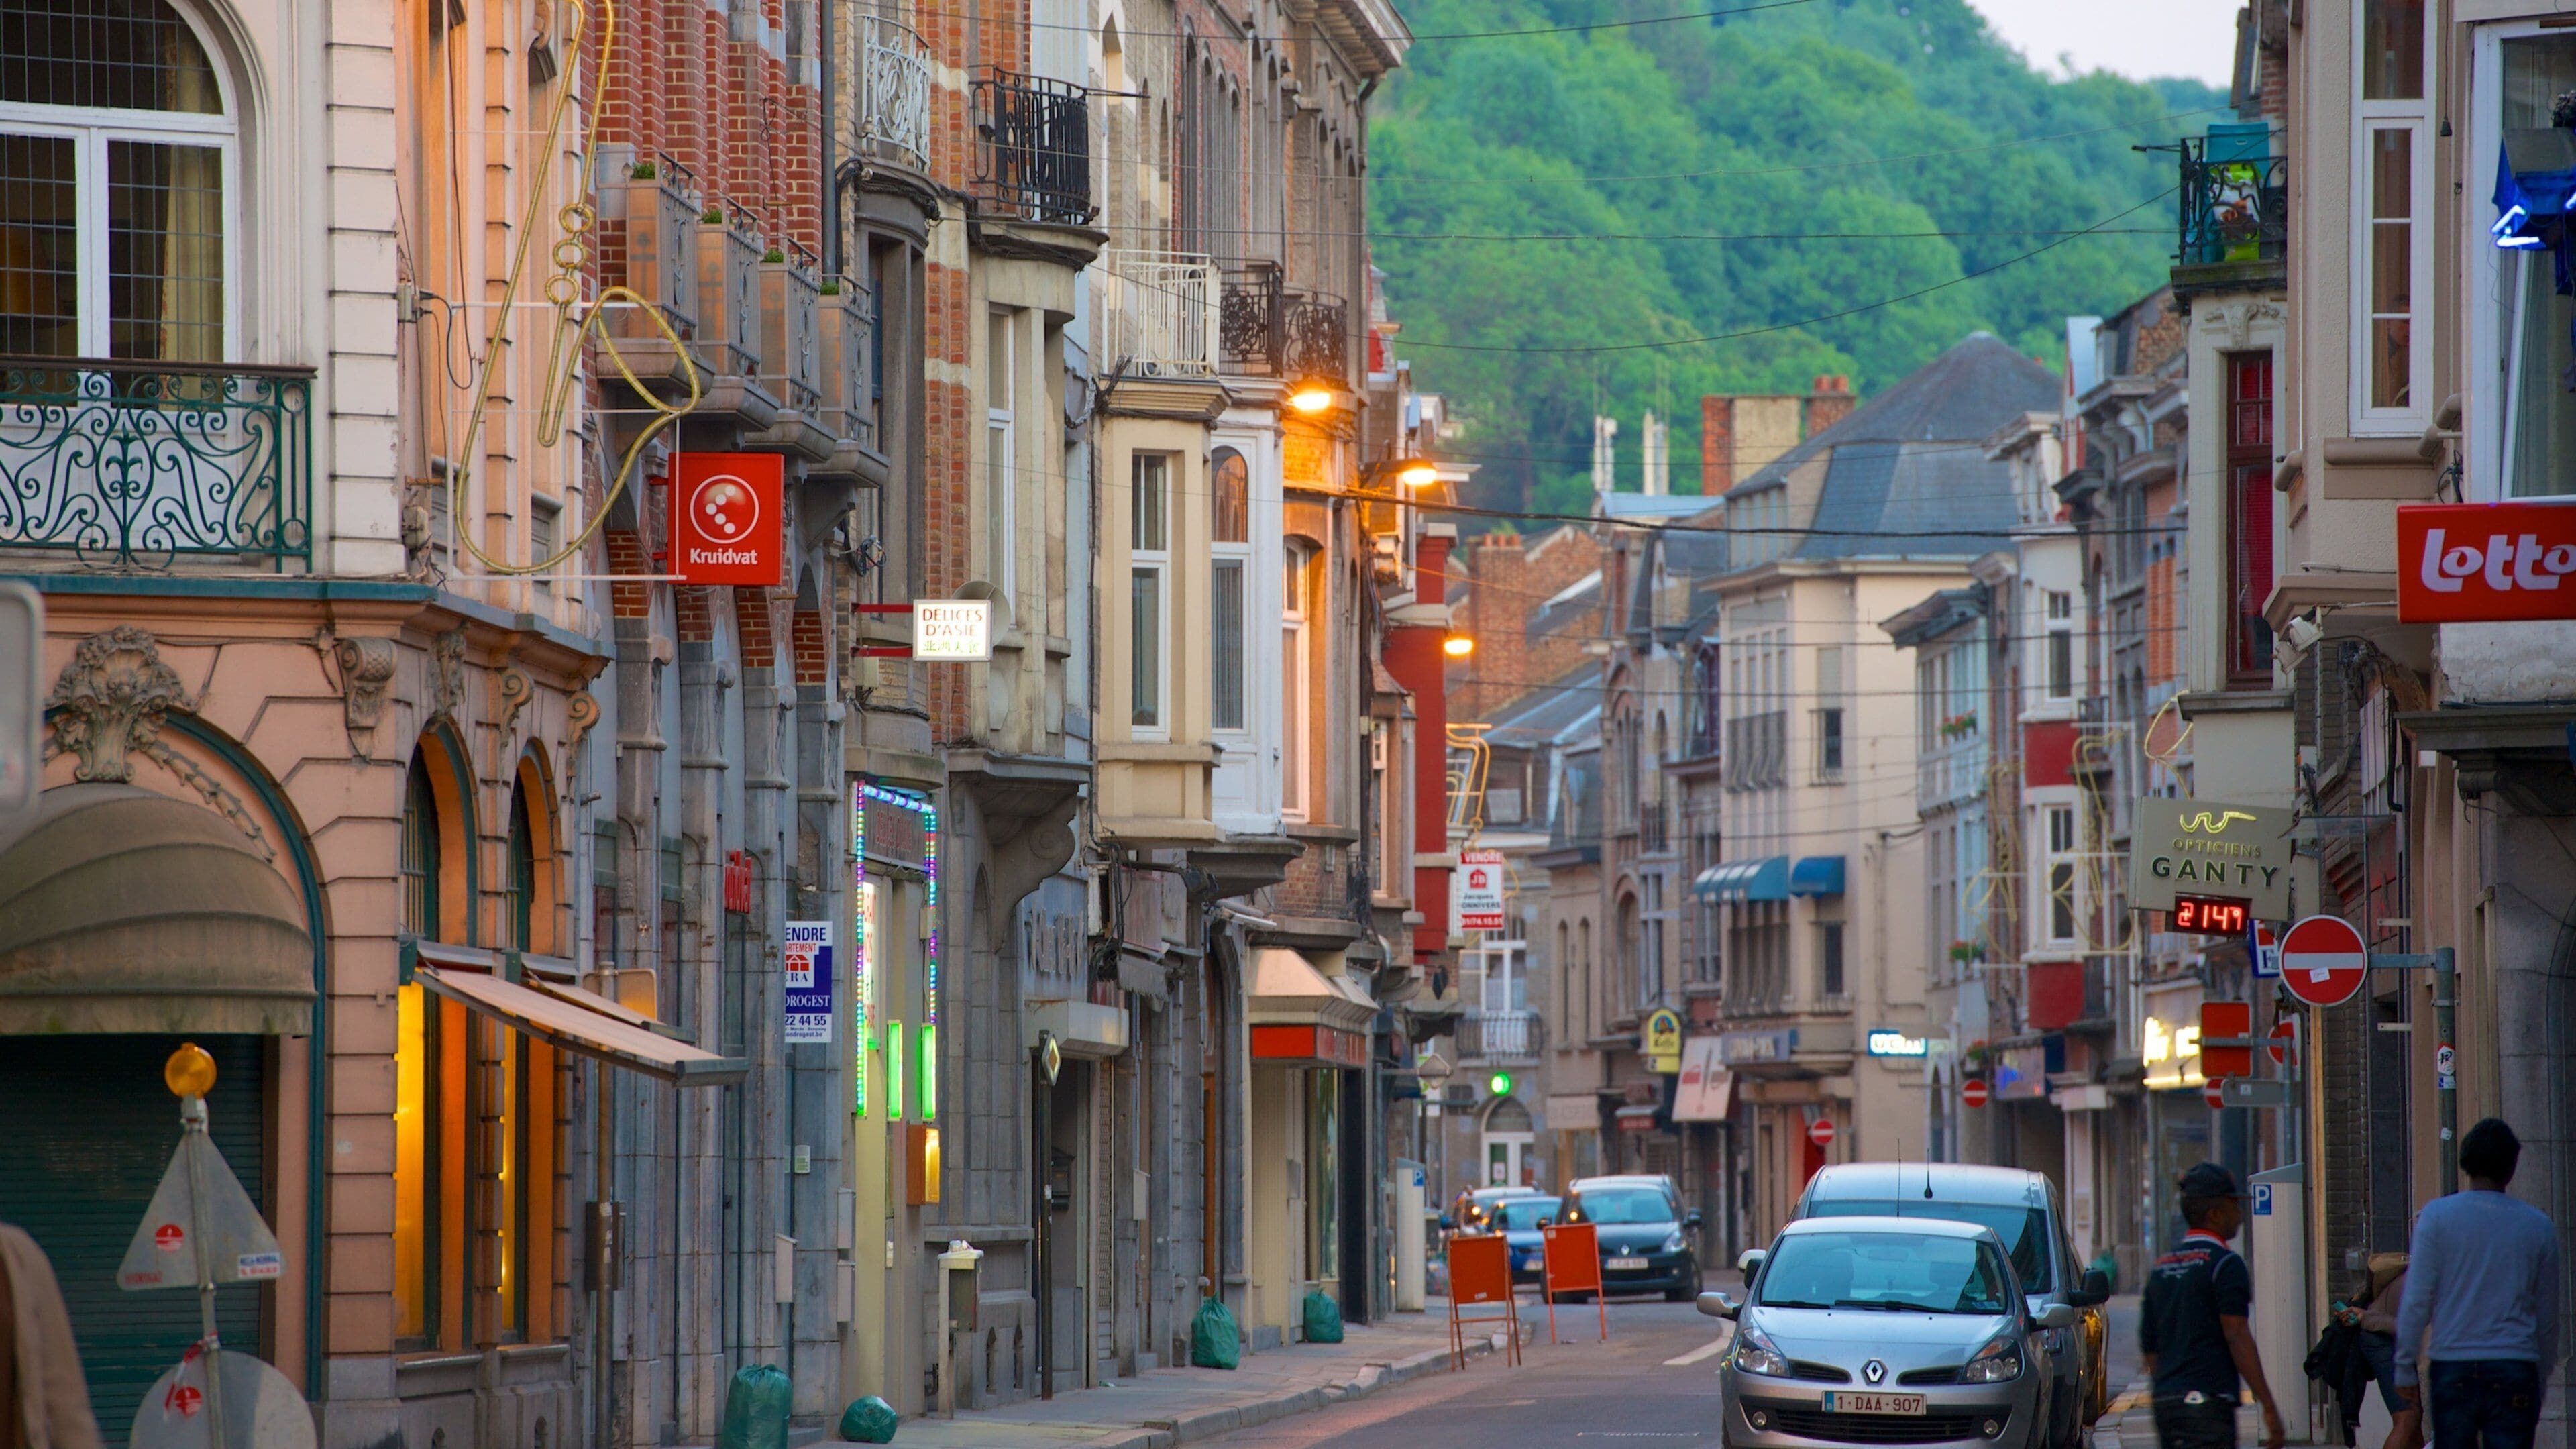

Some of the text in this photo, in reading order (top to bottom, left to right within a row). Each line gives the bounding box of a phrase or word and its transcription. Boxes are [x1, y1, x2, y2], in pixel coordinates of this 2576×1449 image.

[690, 547, 758, 564] Kruidvat
[2421, 528, 2576, 592] Lotto
[922, 608, 982, 621] DELICES
[926, 624, 976, 636] D'ASIE
[2171, 838, 2261, 859] OPTICIENS
[1465, 851, 1502, 863] VENDRE
[2151, 856, 2279, 888] GANTY
[786, 972, 808, 982] RA
[799, 1015, 810, 1026] 44
[814, 1015, 826, 1026] 55
